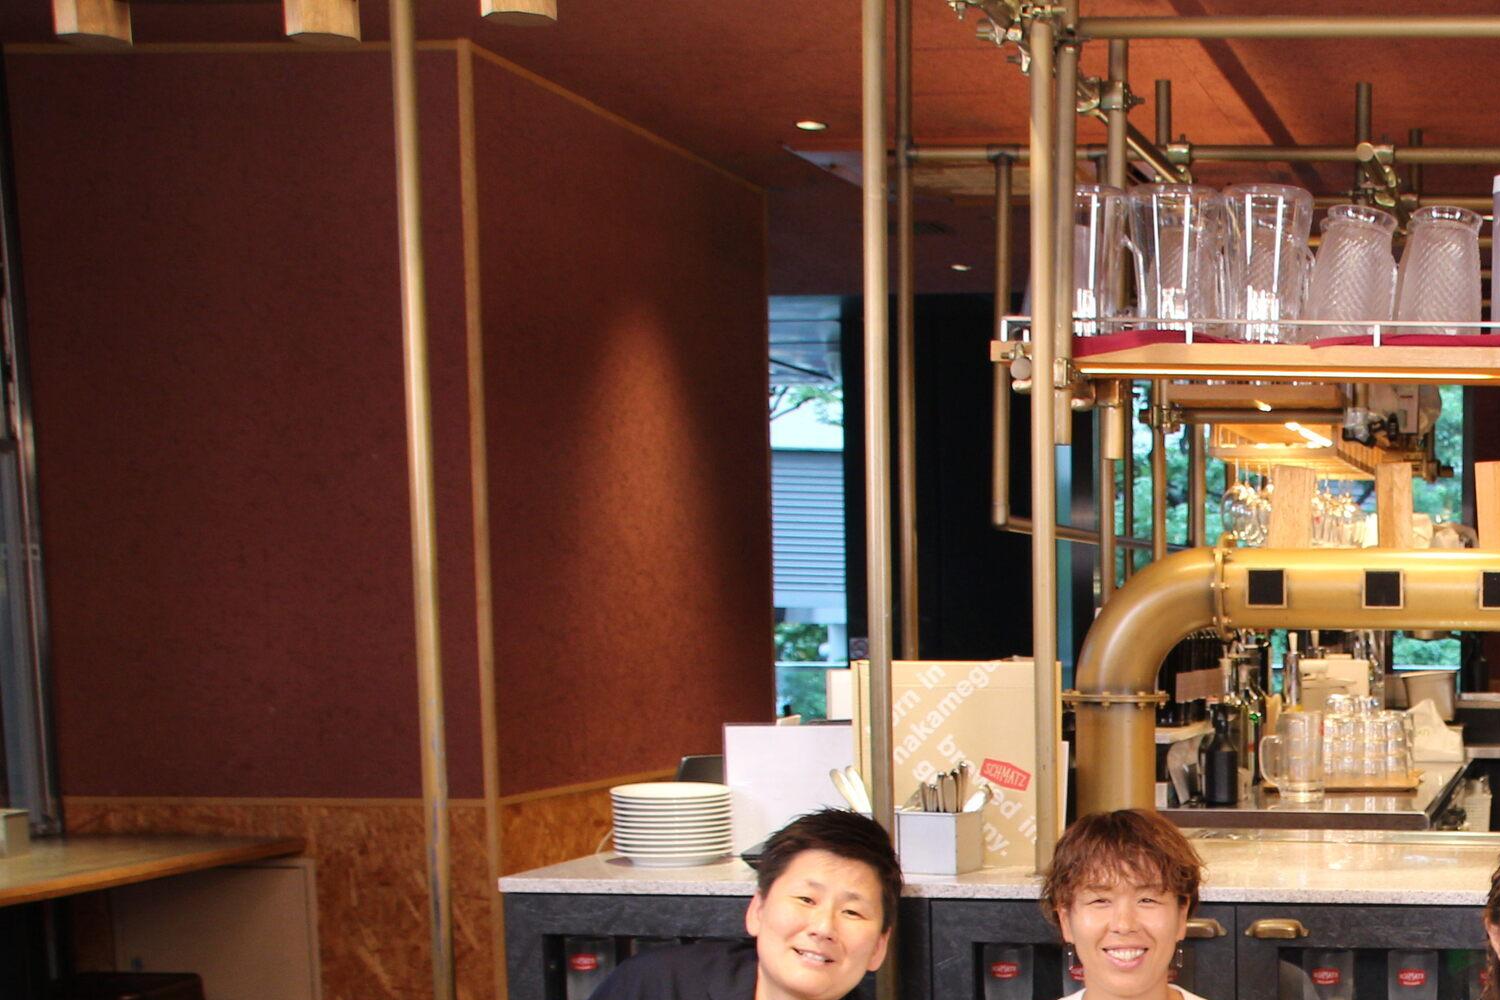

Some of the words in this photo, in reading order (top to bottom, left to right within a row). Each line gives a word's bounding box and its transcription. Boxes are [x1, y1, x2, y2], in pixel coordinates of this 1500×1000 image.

[892, 689, 921, 727] rn
[915, 665, 946, 690] in
[937, 734, 1023, 819] bred
[983, 763, 1027, 787] SCHMATZ
